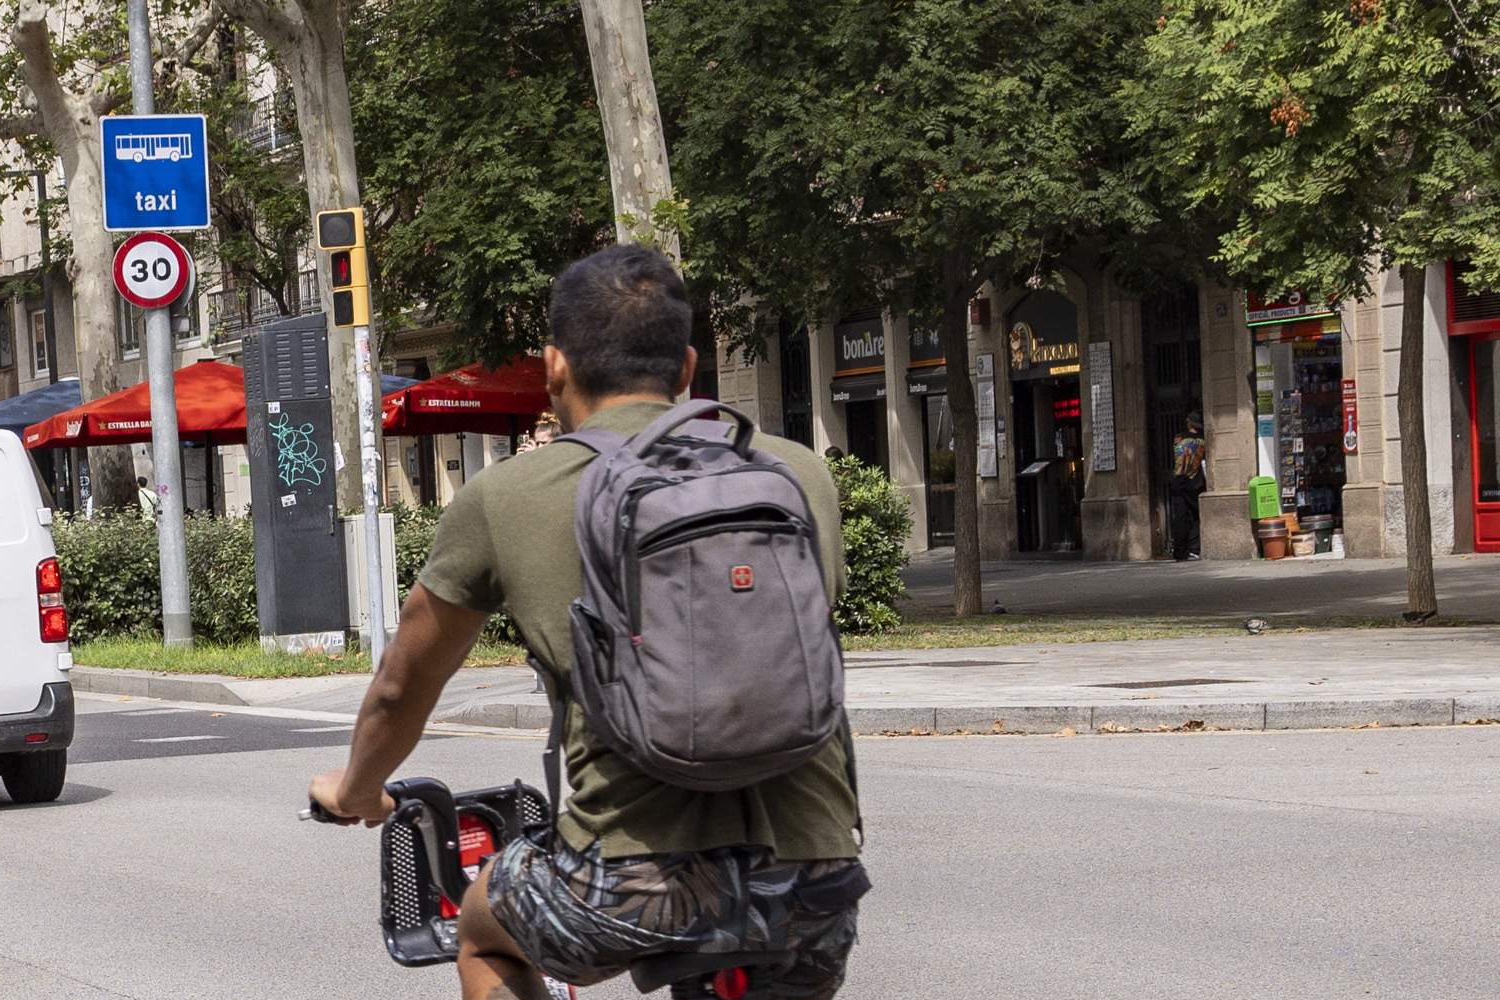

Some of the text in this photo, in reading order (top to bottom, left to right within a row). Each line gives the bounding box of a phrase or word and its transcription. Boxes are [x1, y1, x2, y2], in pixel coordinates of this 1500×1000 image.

[135, 189, 177, 211] taxi
[130, 257, 172, 283] 30
[428, 399, 481, 408] ESTRELLA DAMM
[107, 421, 140, 430] ESTRELLA
